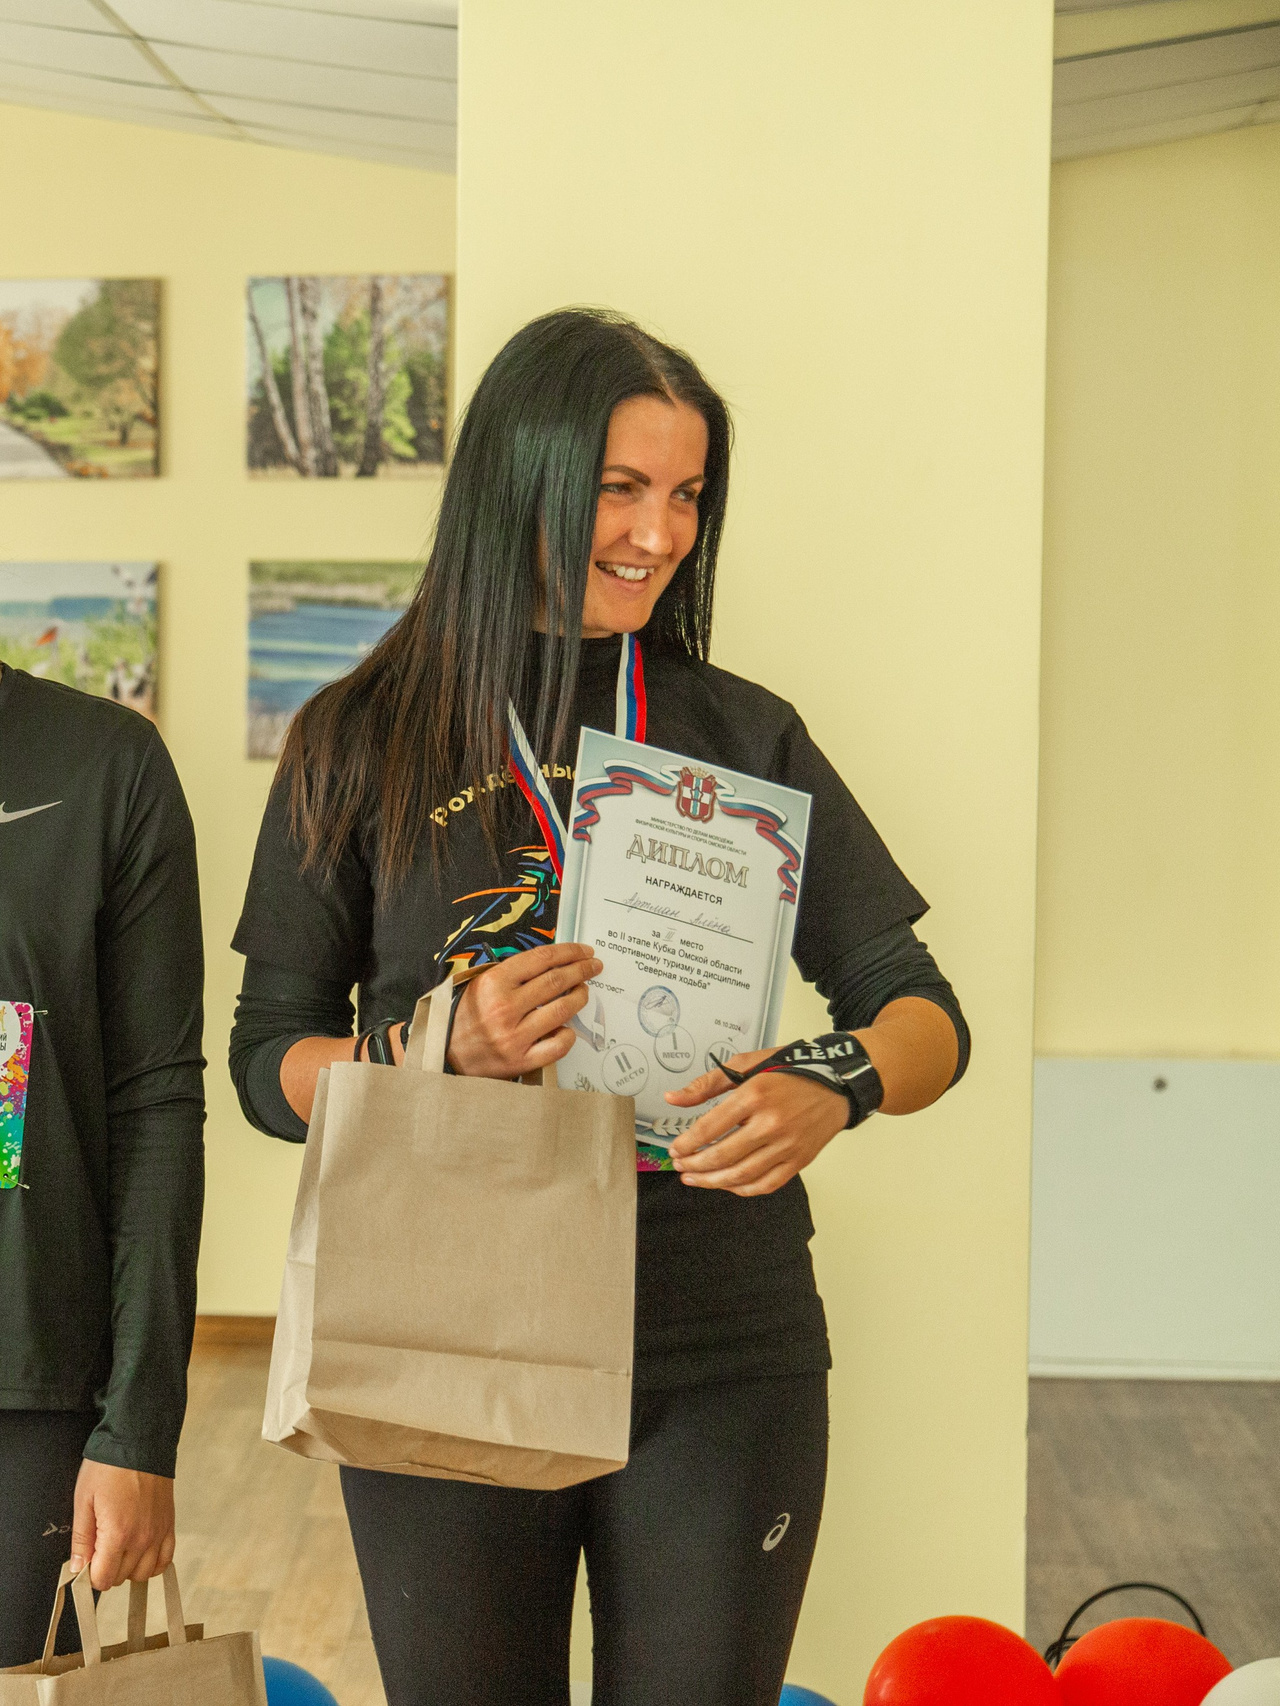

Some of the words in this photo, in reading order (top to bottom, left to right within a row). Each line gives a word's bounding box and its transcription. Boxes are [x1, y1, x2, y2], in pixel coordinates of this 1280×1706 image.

[625, 833, 749, 888] ДИПЛОМ
[645, 875, 722, 905] НАГРАЖДАЕТСЯ
[607, 929, 618, 938] во
[620, 931, 625, 940] II
[627, 935, 650, 947] этапе
[652, 941, 676, 955] Кубка
[678, 948, 708, 964] Омской
[710, 959, 742, 974] области
[651, 930, 660, 938] за
[680, 938, 703, 951] место
[595, 938, 606, 947] по
[607, 942, 660, 964] спортивному
[663, 958, 694, 974] туризму
[702, 970, 750, 990] дисциплине
[634, 960, 677, 980] "Северная
[678, 976, 710, 989] ходьба"
[714, 1018, 741, 1032] 05.10.2024
[793, 1041, 854, 1061] LEKI
[616, 1067, 645, 1088] МЕСТО
